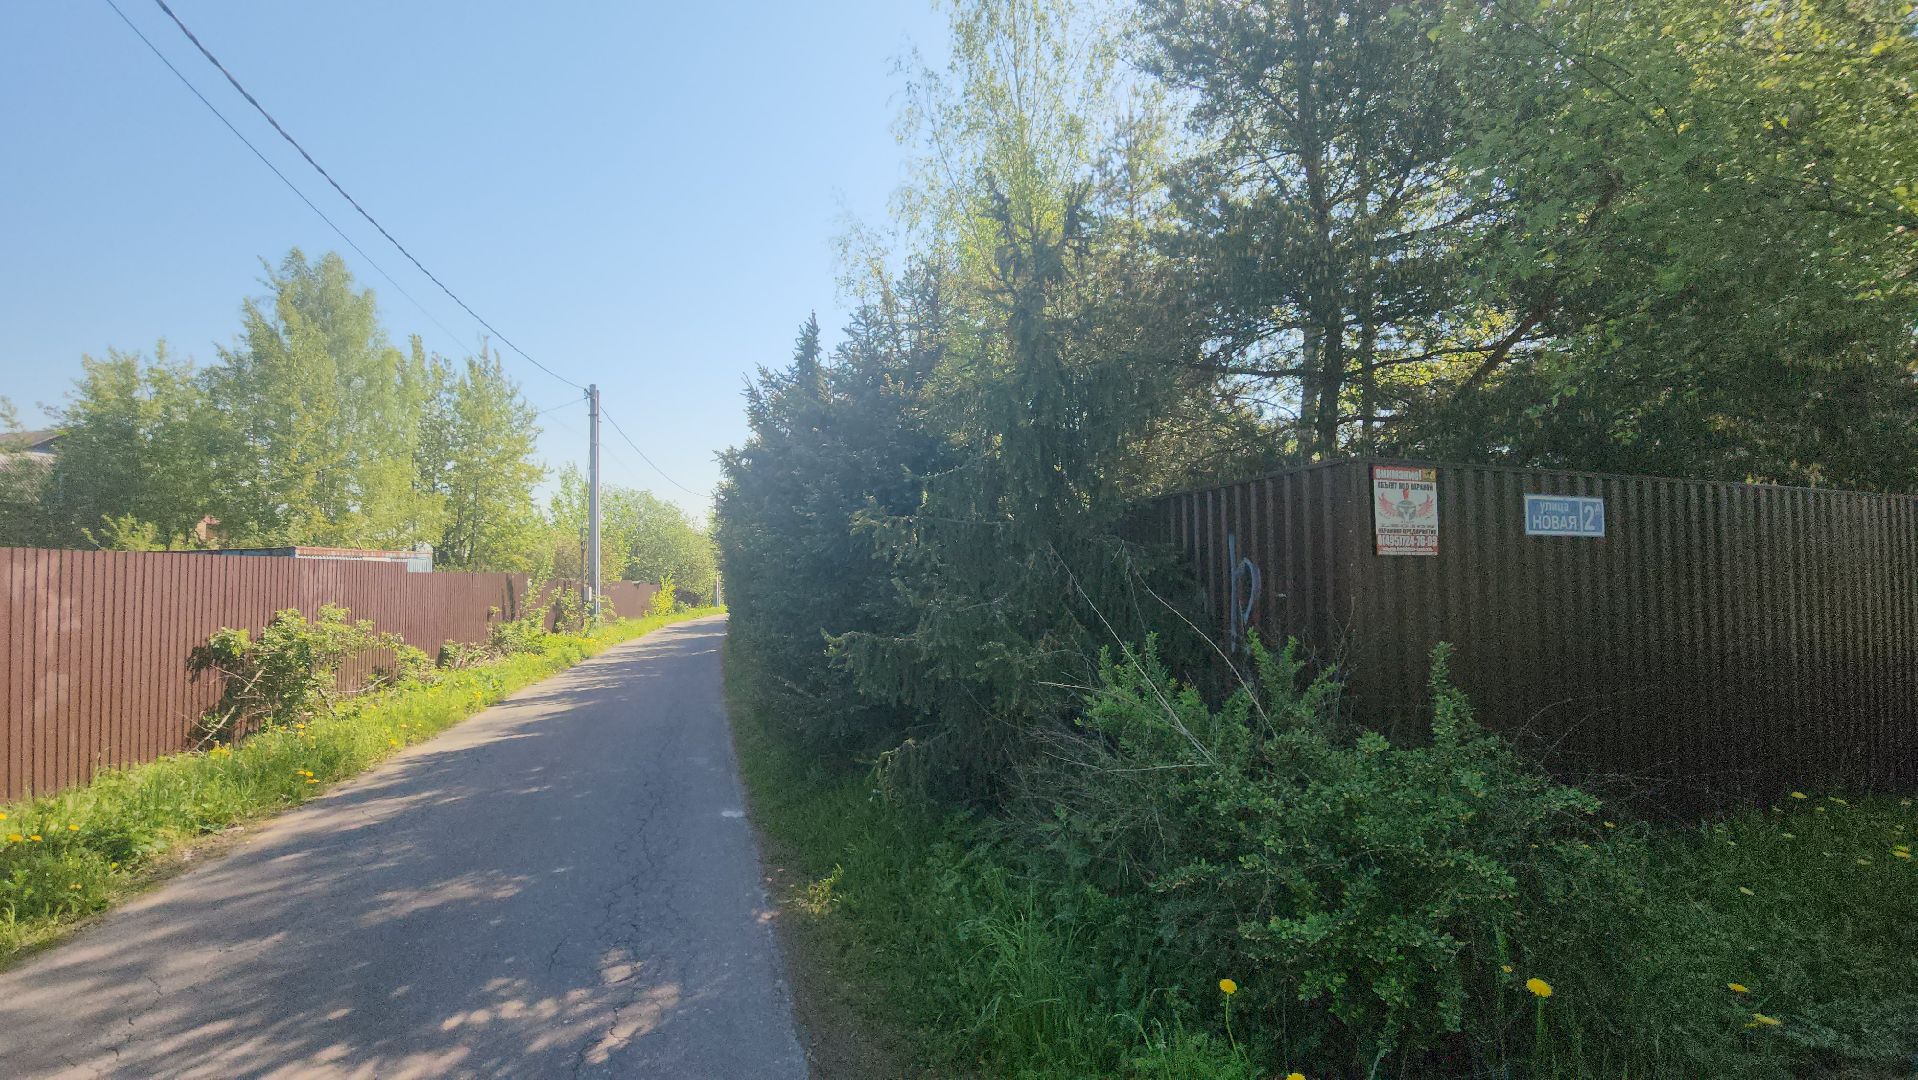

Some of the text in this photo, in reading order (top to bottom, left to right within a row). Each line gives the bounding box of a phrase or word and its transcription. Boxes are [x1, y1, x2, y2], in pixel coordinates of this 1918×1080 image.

[1377, 481, 1397, 489] ОБЪЕКТ
[1399, 482, 1410, 490] ПОД
[1540, 502, 1569, 514] улица
[1532, 515, 1577, 530] НОВАЯ
